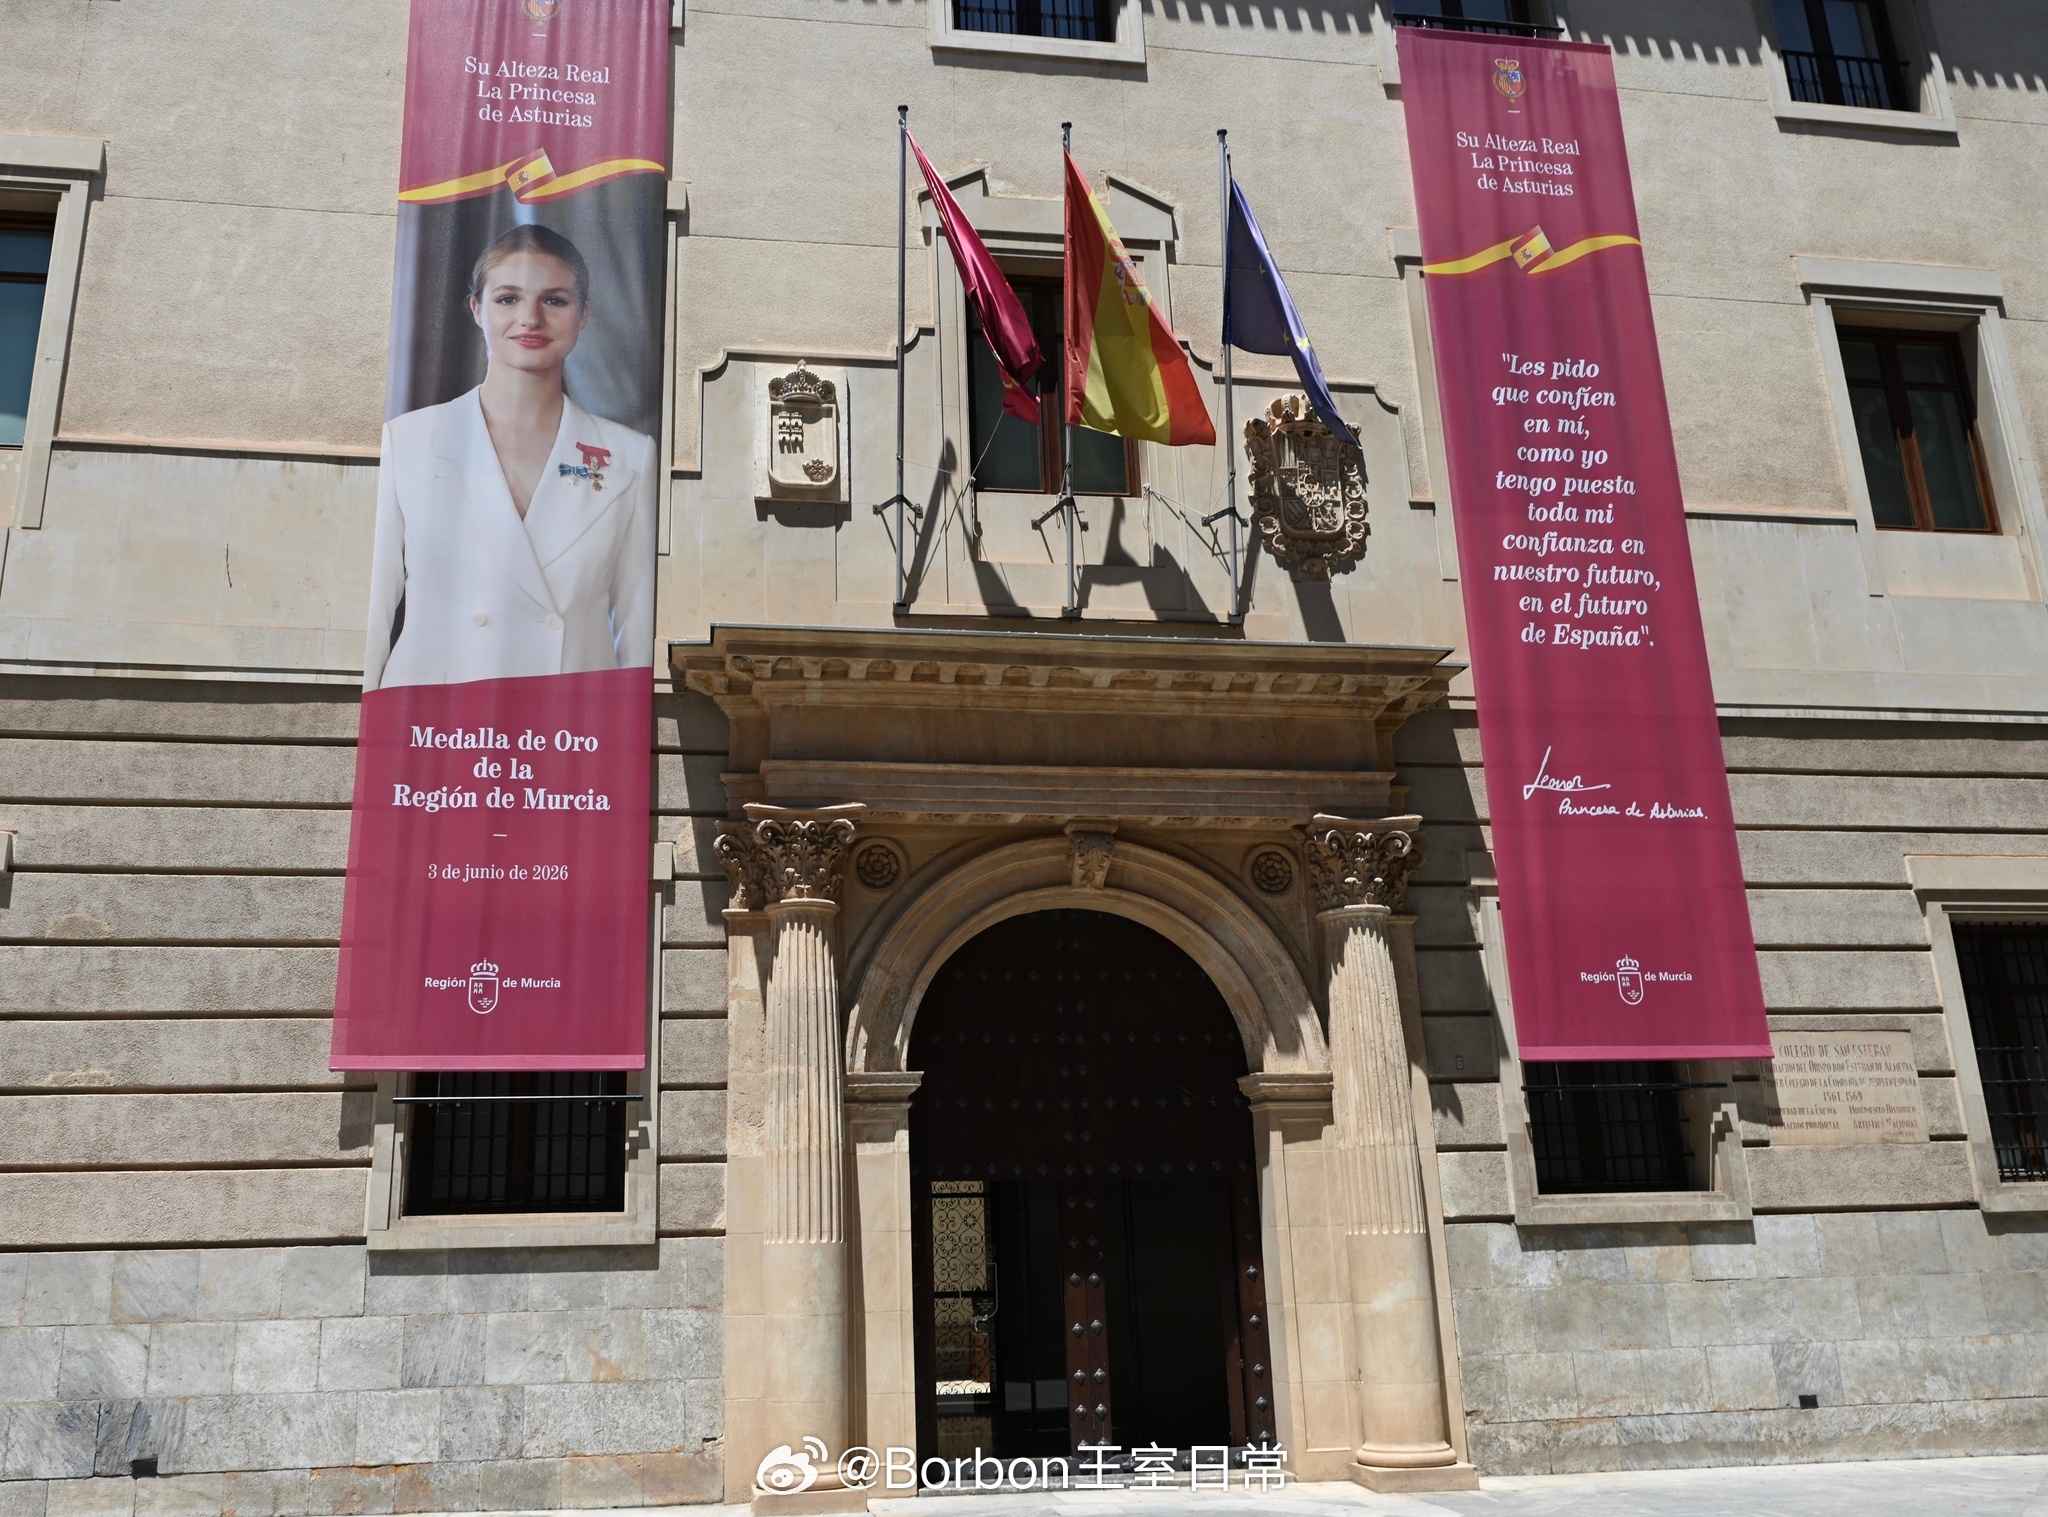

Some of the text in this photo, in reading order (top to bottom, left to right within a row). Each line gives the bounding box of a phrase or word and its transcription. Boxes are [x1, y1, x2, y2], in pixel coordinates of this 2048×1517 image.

[464, 56, 610, 83] Su Alteza Real
[476, 80, 597, 105] La Princesa
[478, 104, 593, 127] de Asturias
[1456, 132, 1580, 155] Su Alteza Real
[1470, 153, 1574, 175] La Princesa
[1477, 174, 1574, 196] de Asturias
[1550, 358, 1600, 379] pido
[1491, 387, 1617, 410] que confíen
[1523, 415, 1590, 439] en mí,
[1516, 447, 1609, 469] como yo
[1495, 471, 1636, 496] tengo puesta
[1527, 502, 1615, 523] toda mi
[1502, 532, 1646, 557] confianza en
[1493, 563, 1661, 591] nuestro futuro,
[1518, 593, 1648, 618] en el futuro
[1520, 622, 1546, 643] de
[409, 726, 599, 752] Medalla de Oro
[473, 757, 534, 779] de la
[391, 784, 611, 812] Región de Murcia
[1558, 798, 1621, 815] Princesa
[1625, 801, 1646, 817] de
[428, 864, 569, 882] 3 de junio de 2026
[424, 976, 561, 990] Región de Murcia
[1580, 971, 1693, 984] Región de Murcia
[1456, 1056, 1463, 1069] 6
[1778, 1045, 1815, 1058] COLEGIO
[1818, 1045, 1831, 1058] DE
